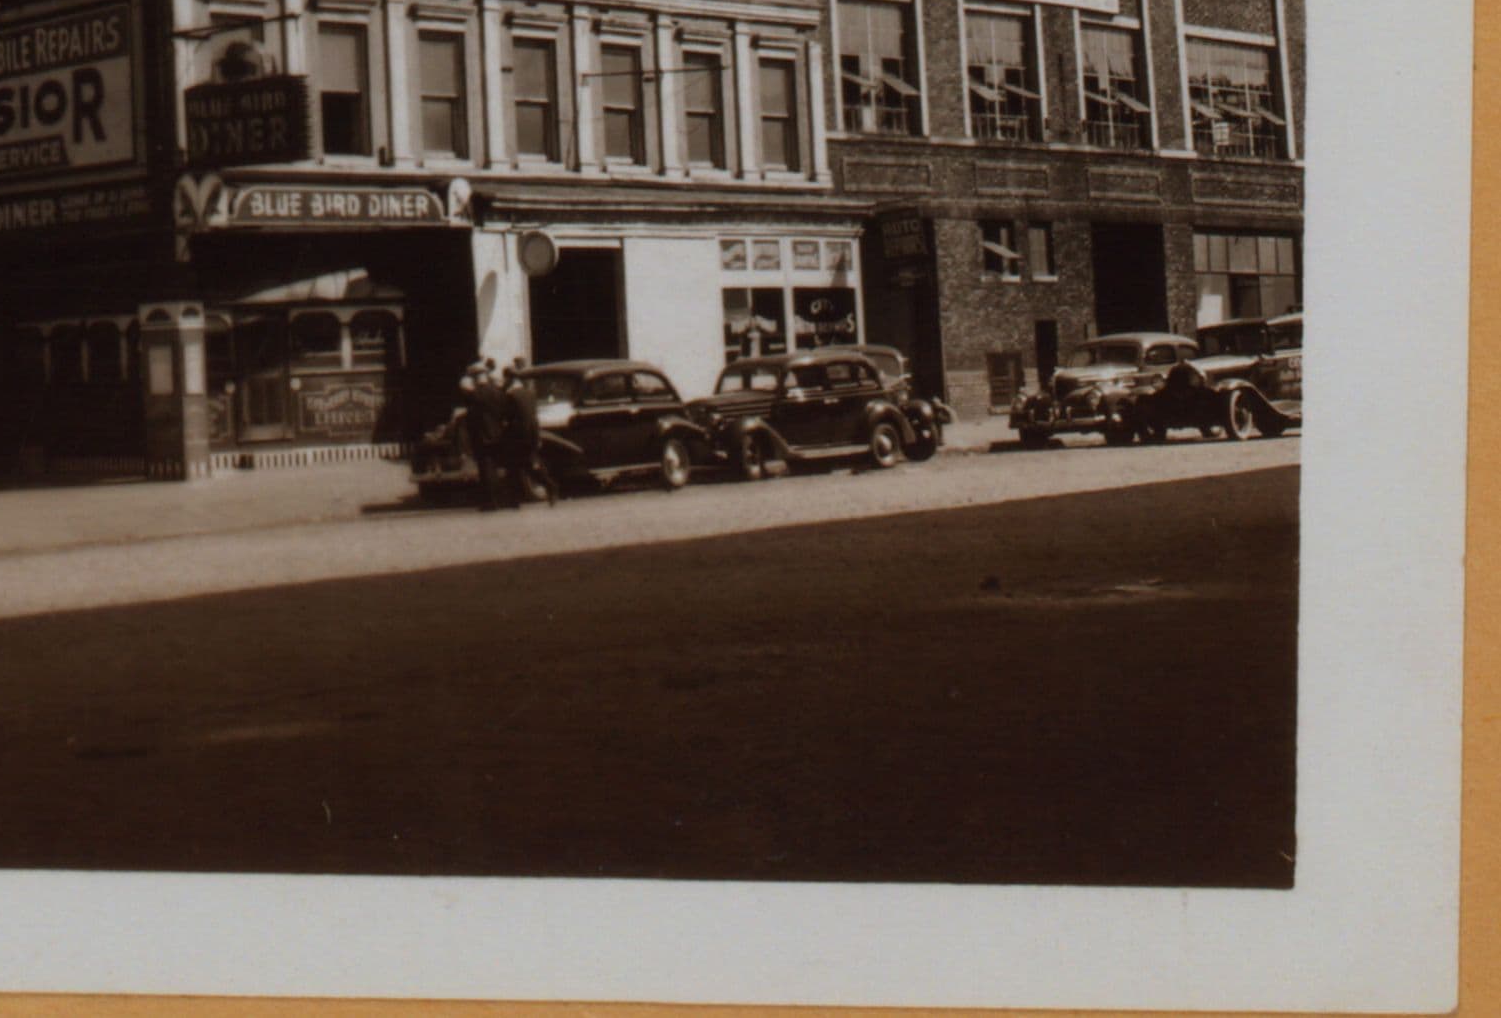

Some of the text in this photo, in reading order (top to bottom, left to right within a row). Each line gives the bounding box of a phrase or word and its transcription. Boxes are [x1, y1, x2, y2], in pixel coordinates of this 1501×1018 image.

[34, 16, 121, 65] REPAIRS
[188, 115, 288, 155] DINER
[250, 190, 432, 219] BLUE BIRD DINER
